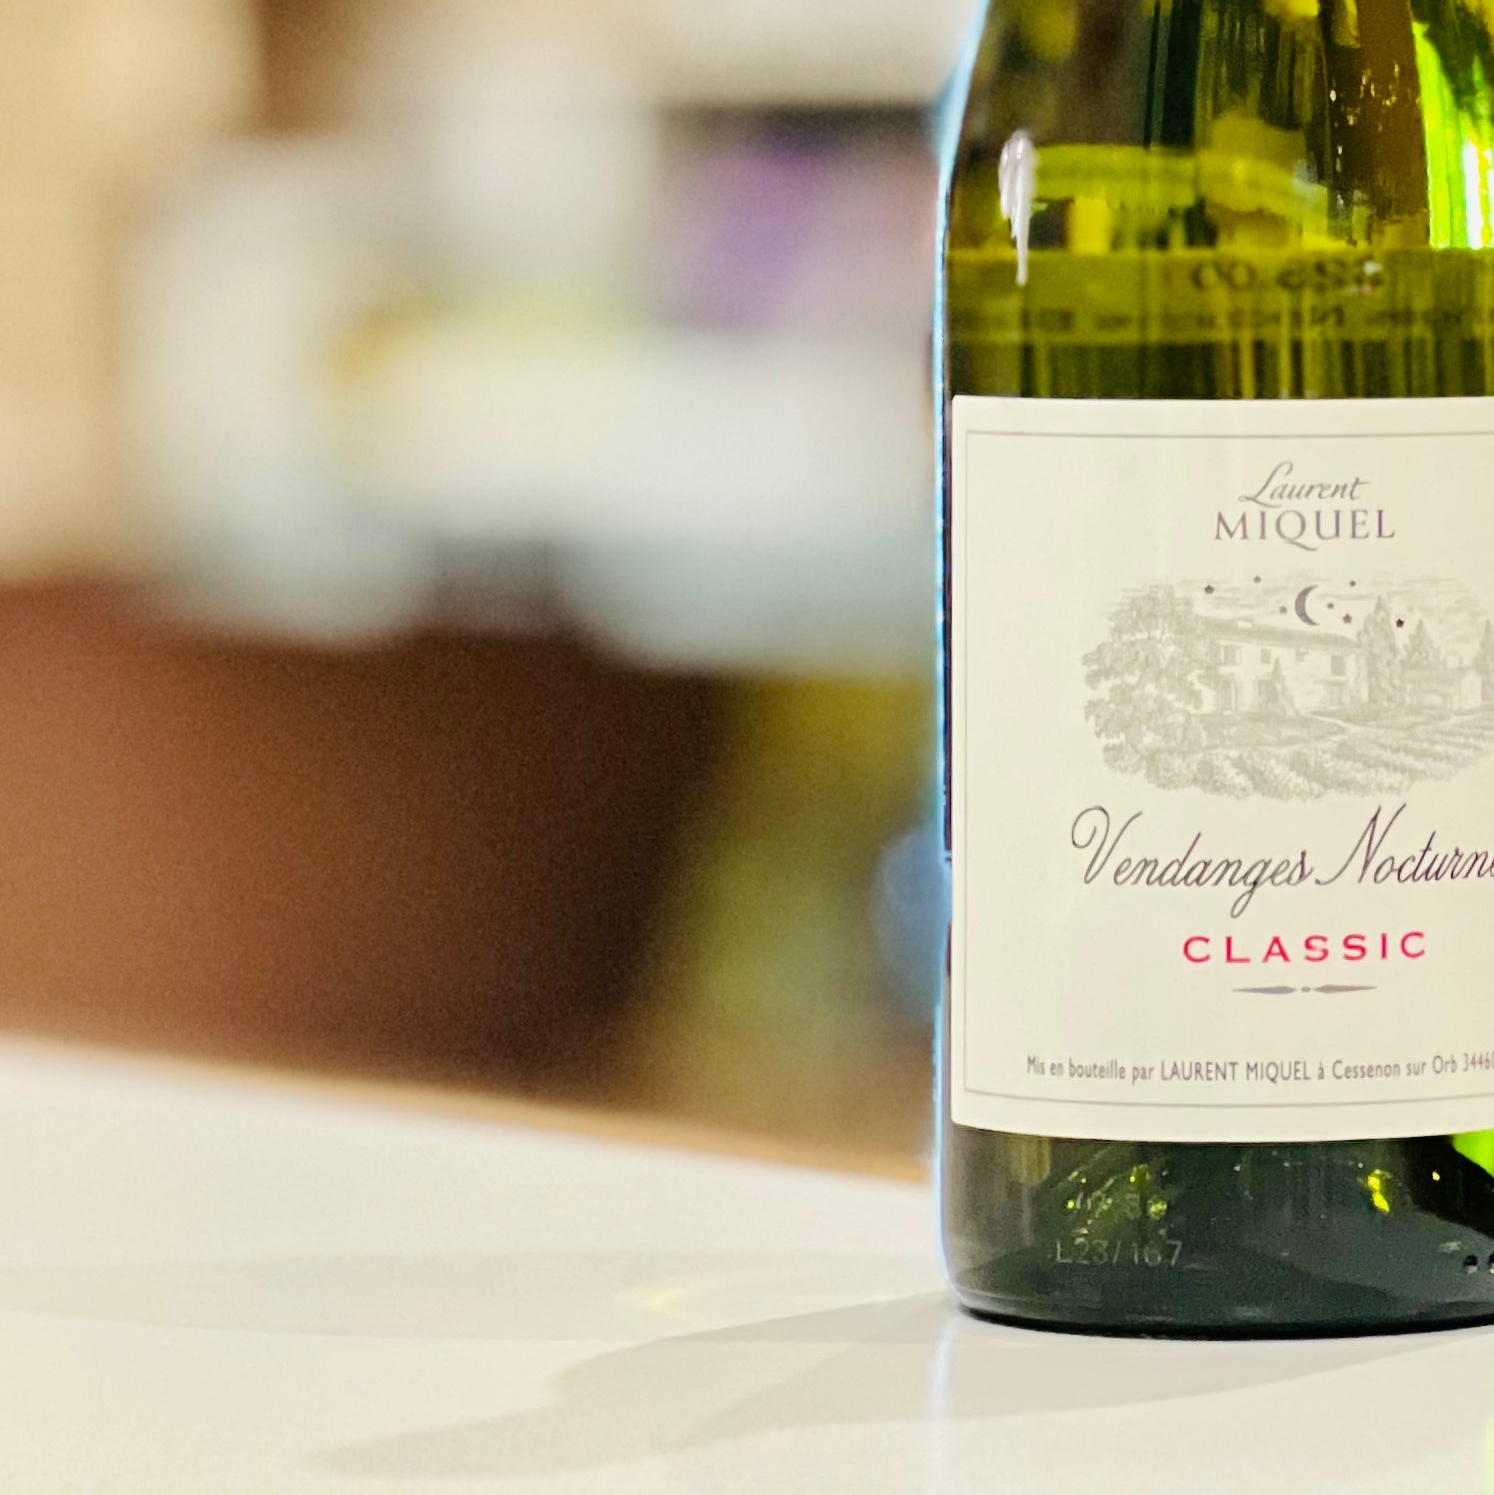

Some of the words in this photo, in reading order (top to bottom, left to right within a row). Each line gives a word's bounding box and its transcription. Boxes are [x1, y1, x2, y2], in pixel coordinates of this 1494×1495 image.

[1238, 460, 1372, 508] Laurent
[1213, 509, 1396, 551] MIQUEL
[1071, 804, 1315, 919] Vendanges
[1182, 931, 1426, 964] CLASSIC
[1027, 1054, 1046, 1076] Mis
[1050, 1060, 1064, 1077] en
[1068, 1057, 1126, 1080] bouteille
[1131, 1065, 1154, 1086] par
[1160, 1060, 1239, 1082] LAURENT
[1246, 1060, 1311, 1084] MIQUEL
[1317, 1060, 1325, 1080] à
[1332, 1059, 1401, 1080] Cessenon
[1406, 1060, 1427, 1077] sur
[1432, 1054, 1458, 1074] Orb
[1056, 1239, 1183, 1267] L23/167
